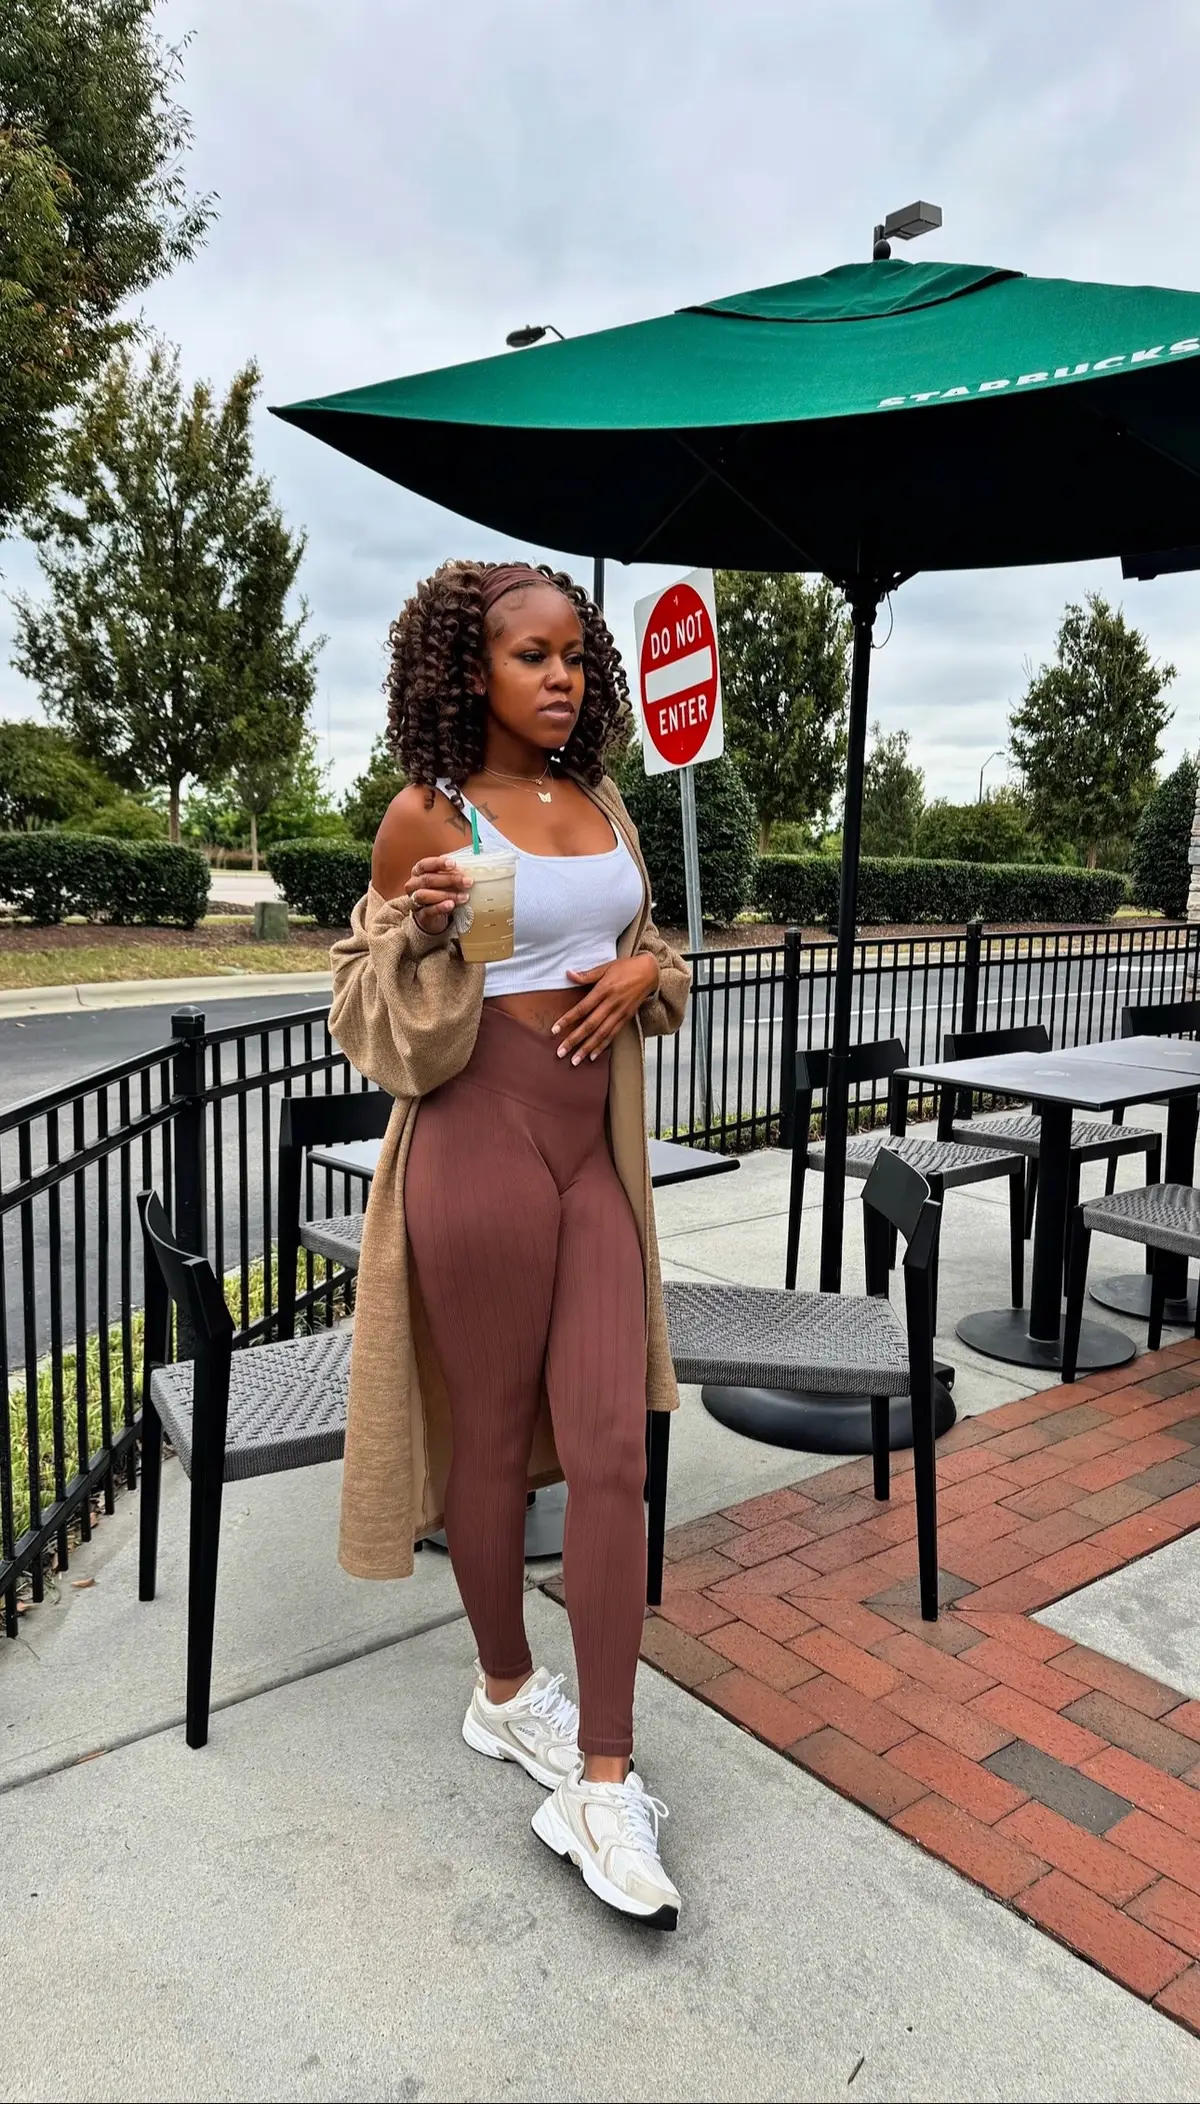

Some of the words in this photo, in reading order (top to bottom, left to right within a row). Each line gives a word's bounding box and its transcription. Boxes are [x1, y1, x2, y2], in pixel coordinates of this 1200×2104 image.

[876, 337, 1200, 408] STARBUCKS
[650, 626, 671, 660] DO
[675, 609, 703, 649] NOT
[659, 694, 708, 736] ENTER
